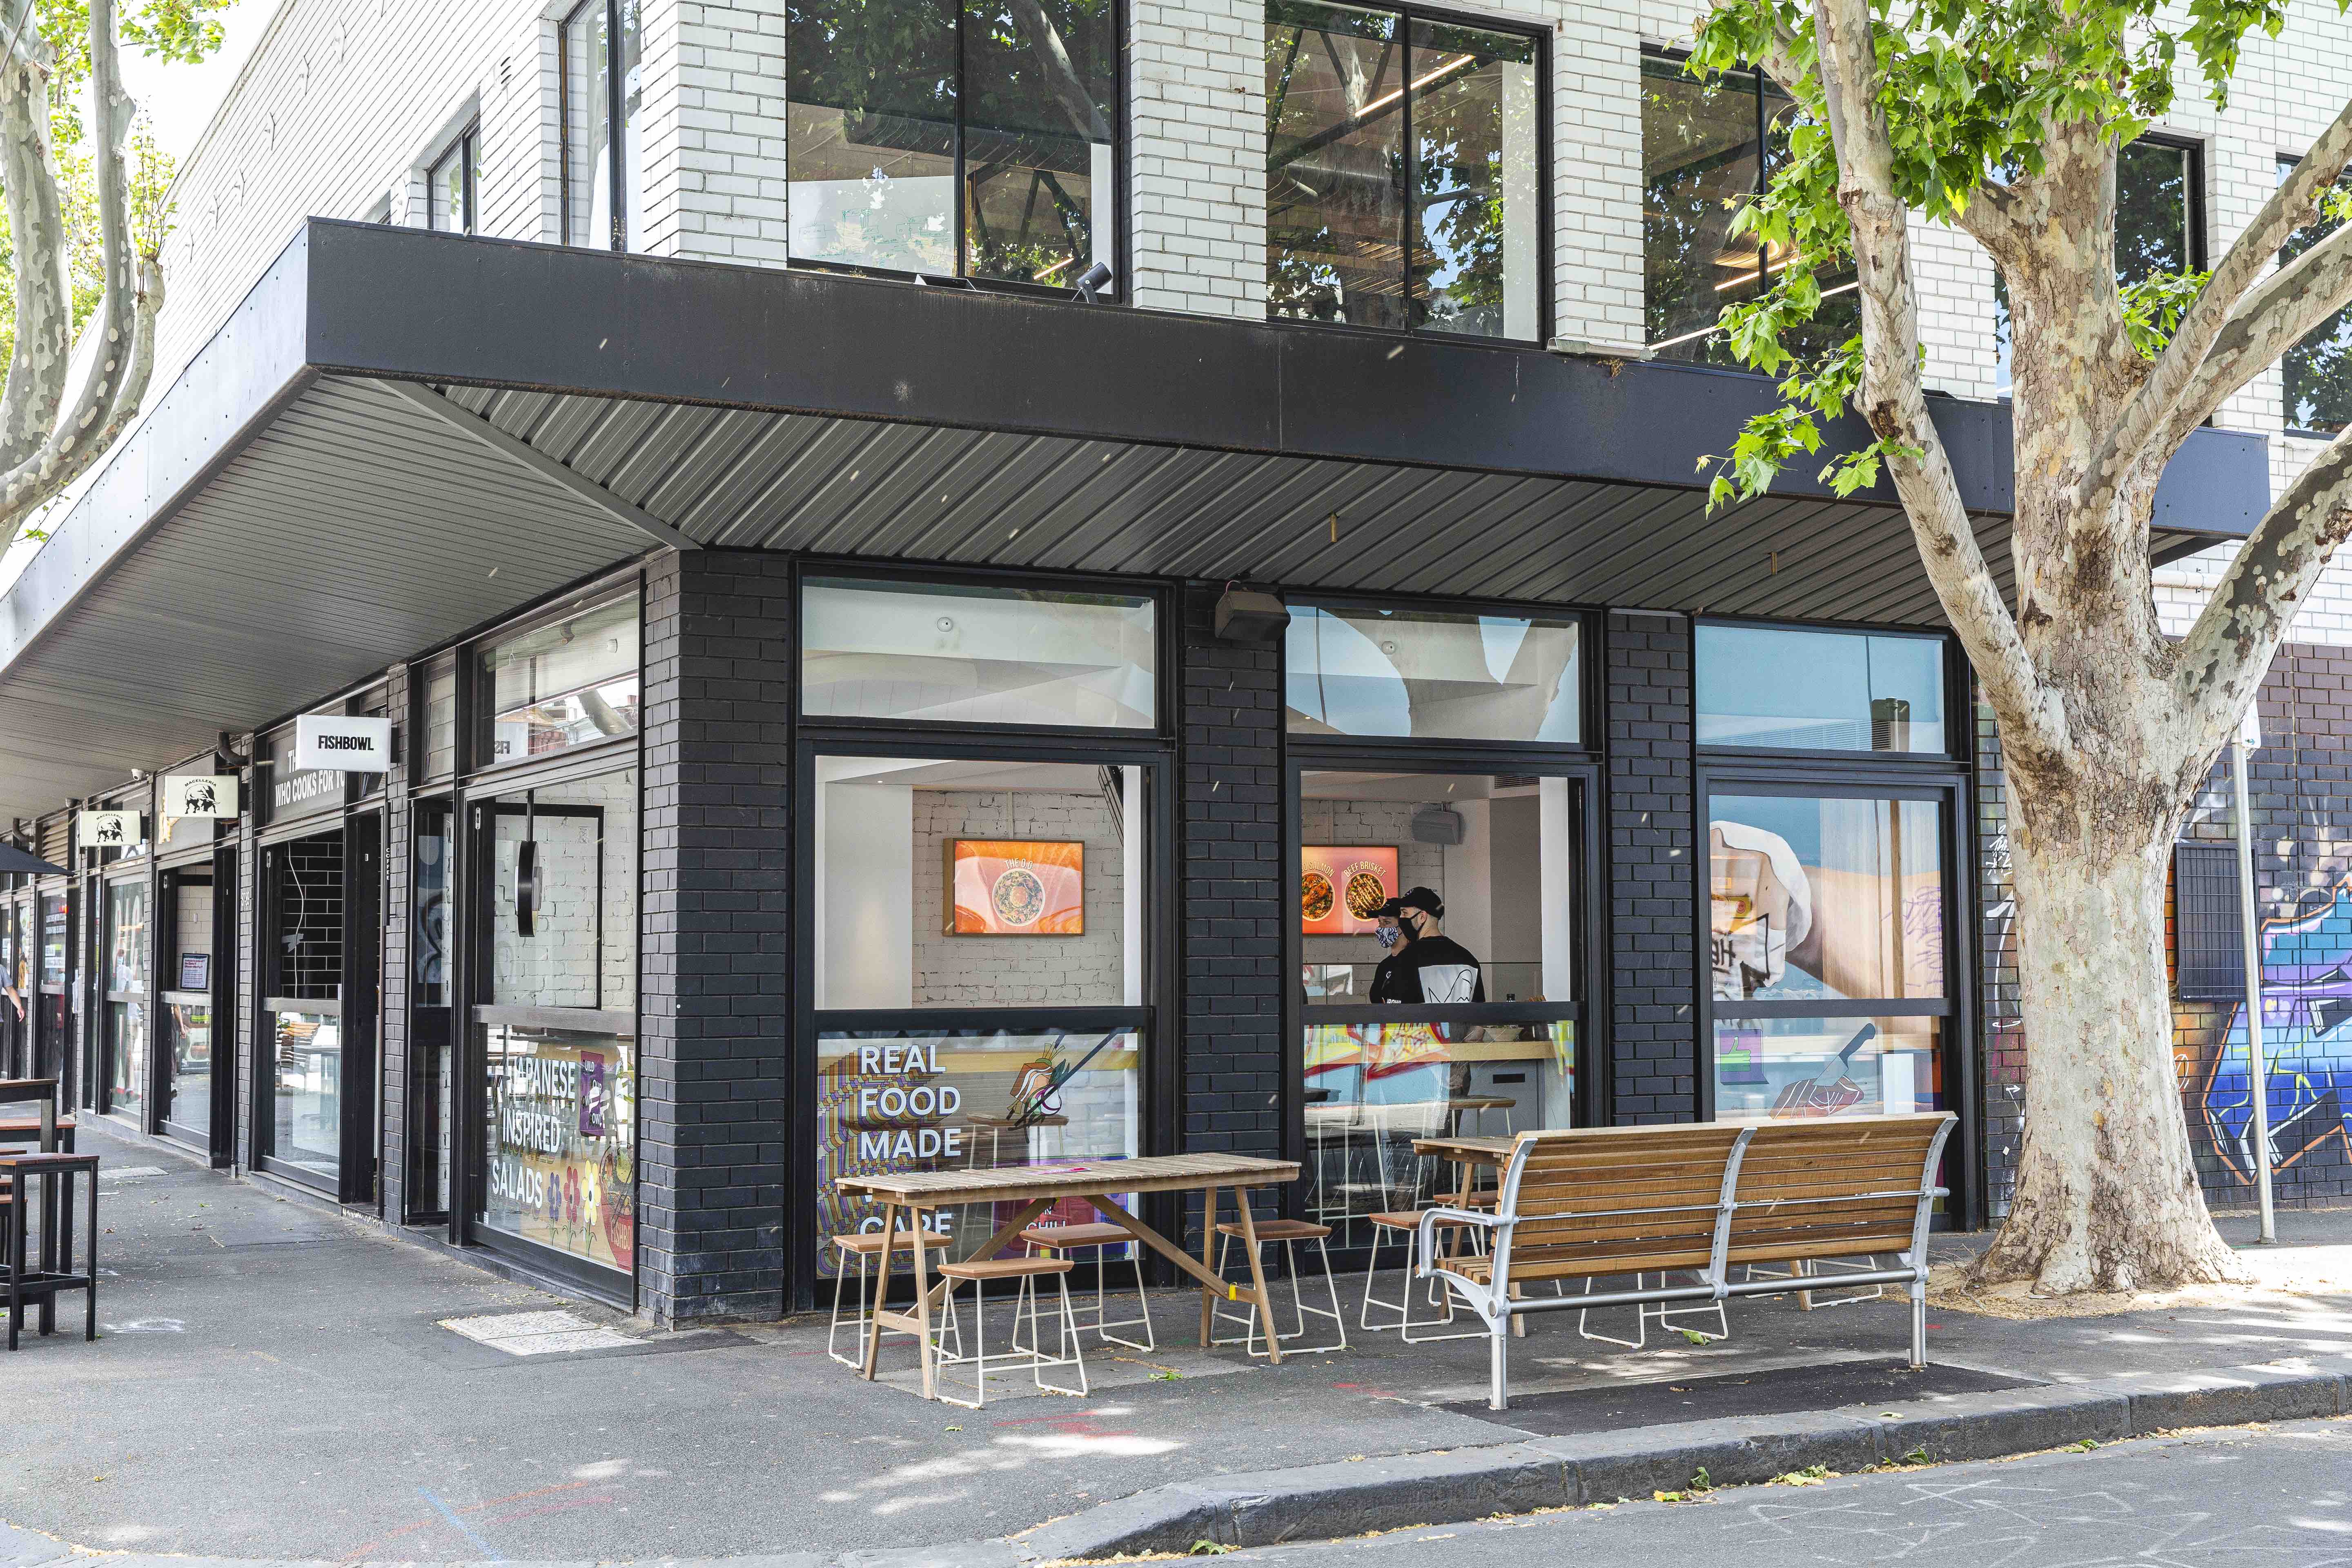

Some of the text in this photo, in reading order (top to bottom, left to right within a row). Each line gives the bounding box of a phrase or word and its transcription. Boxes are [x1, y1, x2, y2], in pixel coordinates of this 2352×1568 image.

[318, 735, 374, 751] FISHBOWL
[185, 778, 217, 787] MACELLERIA
[275, 780, 291, 807] WHO
[292, 771, 317, 802] COOKS
[318, 770, 334, 794] FOR
[1004, 858, 1020, 870] THE
[1309, 861, 1335, 878] SALMON
[1343, 861, 1386, 878] BEEF BRISKET
[583, 1060, 595, 1072] UILD
[861, 1044, 947, 1074] REAL
[861, 1086, 961, 1117] FOOD
[503, 1107, 560, 1153] INSPIRED
[861, 1128, 961, 1160] MADE
[492, 1159, 543, 1209] SALADS
